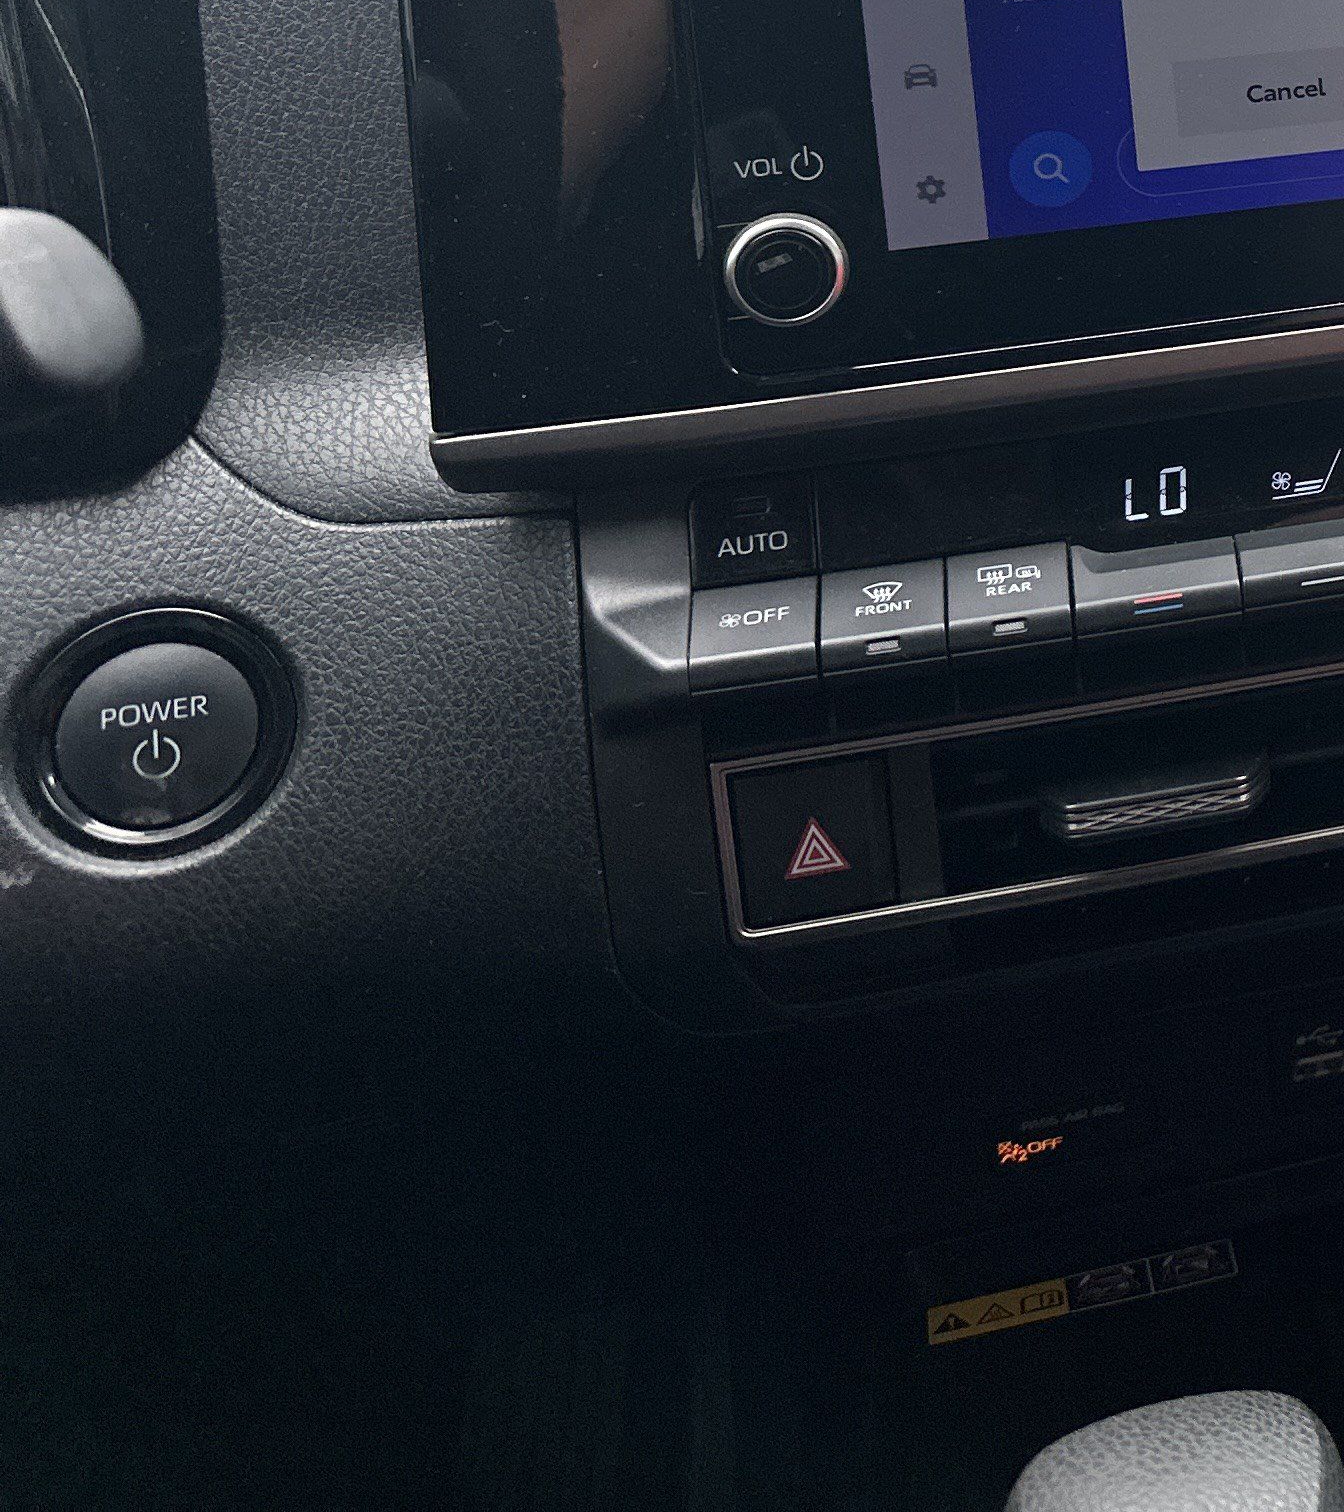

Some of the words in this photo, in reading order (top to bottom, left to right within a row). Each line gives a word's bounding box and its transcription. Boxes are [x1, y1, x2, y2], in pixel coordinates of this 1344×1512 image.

[1246, 78, 1327, 104] Cancel
[734, 158, 783, 179] VOL
[718, 530, 788, 558] AUTO
[985, 581, 1032, 597] REAR
[743, 605, 791, 625] OFF
[854, 599, 913, 617] FRONT
[101, 695, 209, 730] POWER
[1026, 1135, 1064, 1154] OFF
